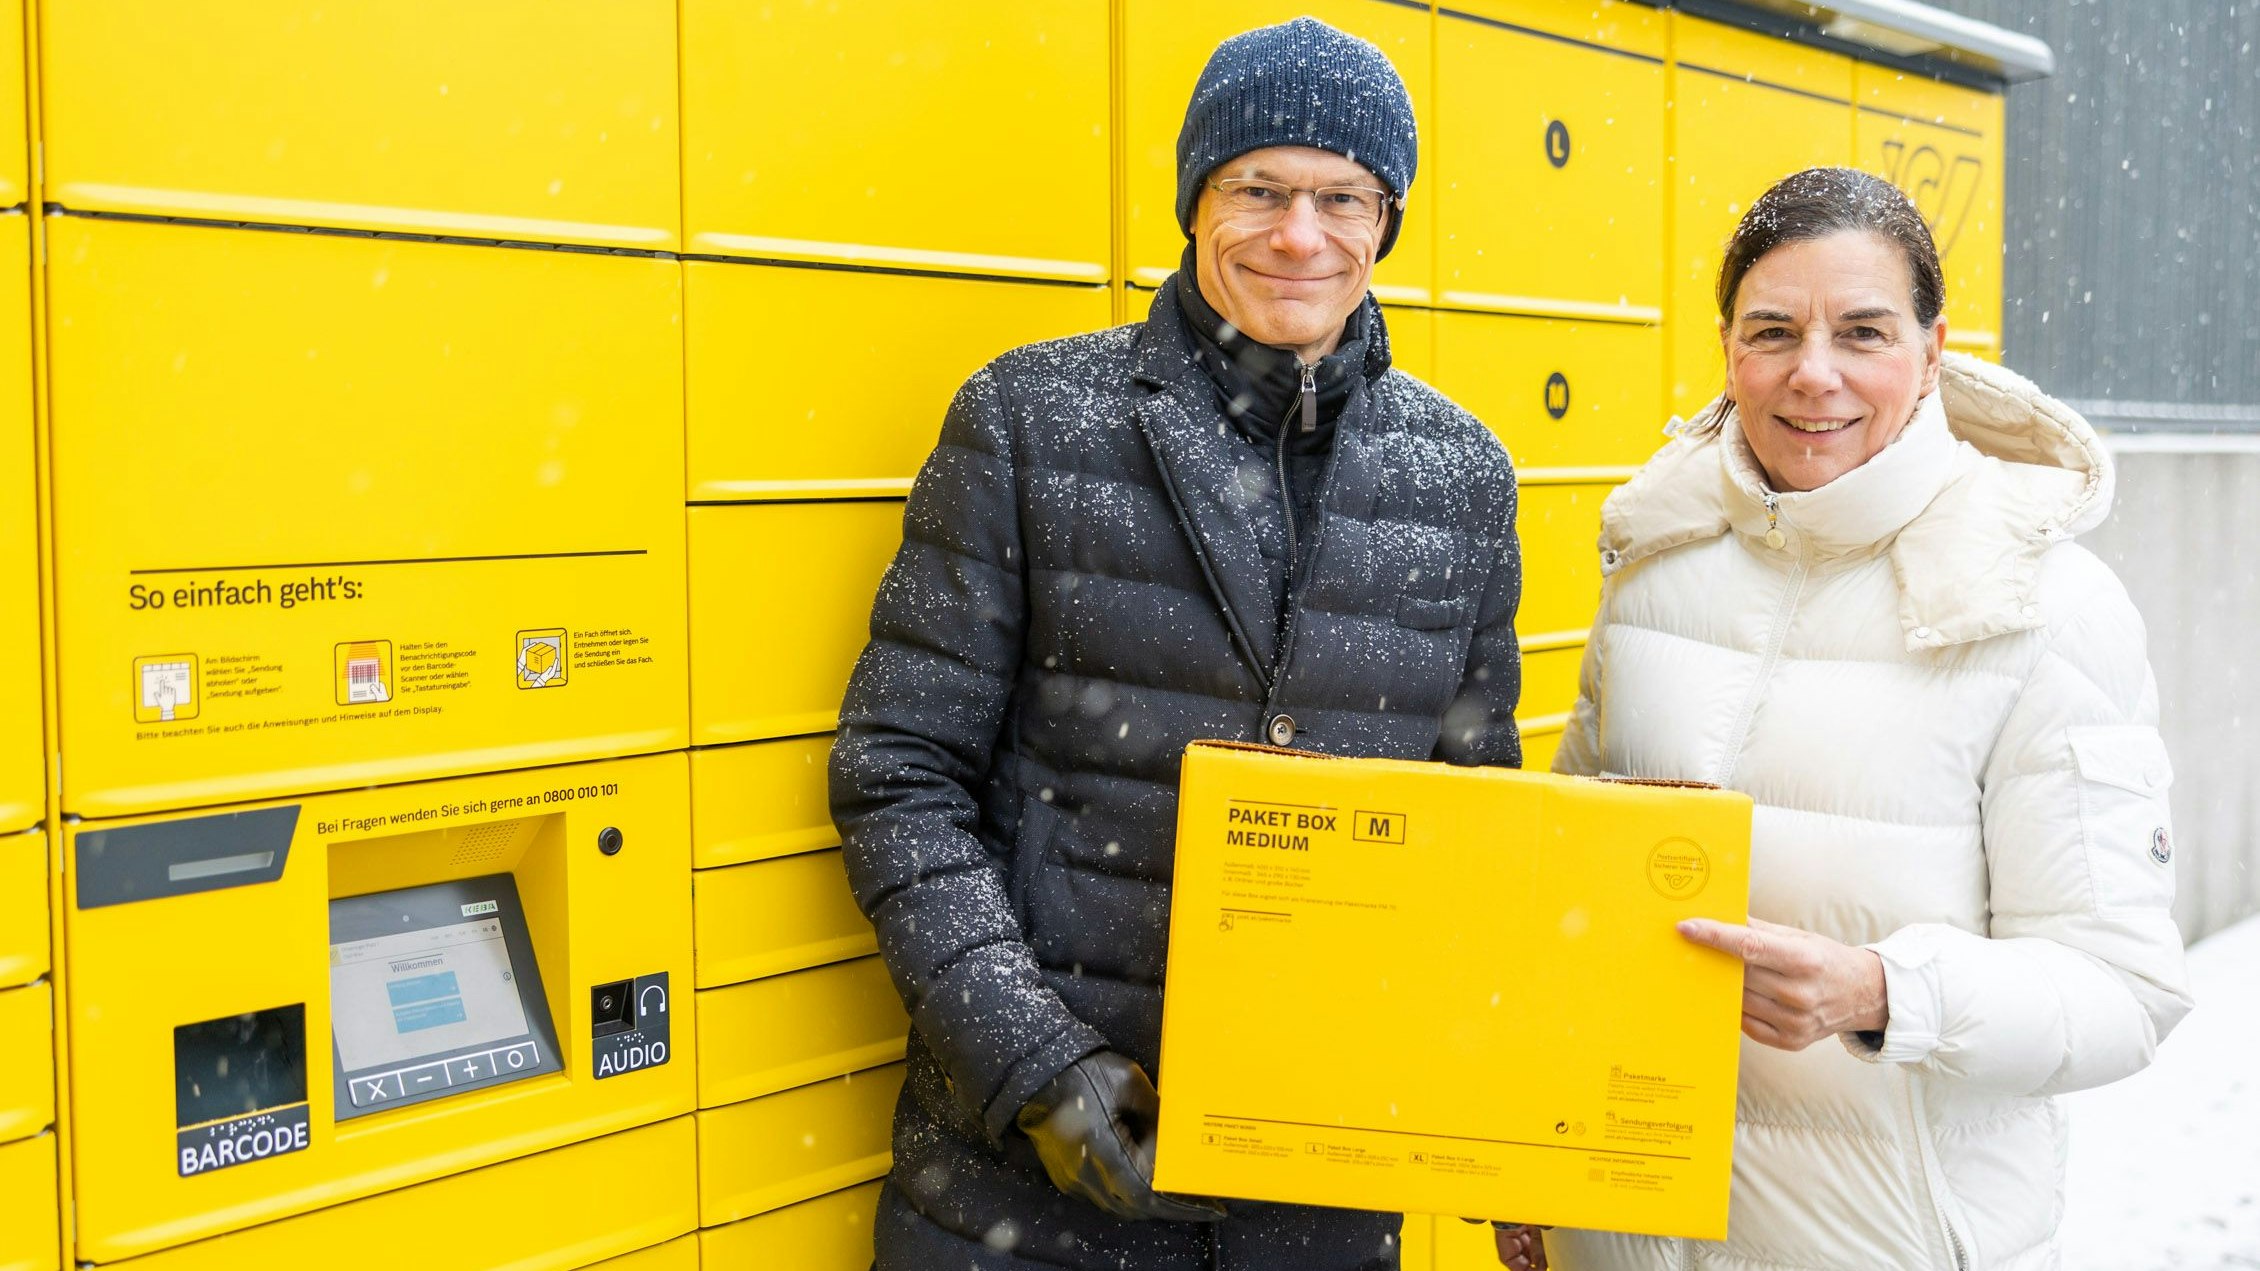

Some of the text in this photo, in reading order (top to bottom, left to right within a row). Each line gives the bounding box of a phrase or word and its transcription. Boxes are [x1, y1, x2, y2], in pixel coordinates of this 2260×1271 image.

[1552, 130, 1564, 158] L
[1549, 382, 1566, 410] M
[130, 576, 363, 610] So einfach geht’s:
[585, 630, 598, 638] Fach
[600, 628, 618, 637] öffnet
[574, 640, 608, 649] Entnehmen
[624, 637, 639, 646] legen
[220, 655, 260, 664] Bildschirm
[400, 650, 477, 662] Benachrichtigungscode
[585, 649, 610, 658] Sendung
[587, 659, 615, 668] schließen
[206, 667, 232, 676] wählen
[401, 674, 427, 683] Scanner
[136, 732, 159, 741] Bitte
[162, 728, 204, 738] beachten
[207, 726, 220, 734] Sie
[224, 722, 244, 732] auch
[247, 721, 261, 730] die
[263, 716, 319, 730] Anweisungen
[321, 715, 337, 724] und
[340, 711, 377, 721] Hinweise
[379, 710, 392, 718] auf
[394, 708, 410, 717] dem
[317, 783, 618, 835] Bei Fragen wenden Sie sich gerne an 0800 010 101
[1229, 808, 1337, 832] PAKET BOX
[1368, 817, 1390, 837] M
[1226, 830, 1309, 851] MEDIUM
[464, 902, 496, 914] KEBA
[390, 957, 444, 973] Willkommen
[598, 1041, 666, 1076] AUDIO
[1624, 1072, 1666, 1082] Paketmarke
[1620, 1118, 1693, 1132] Sendungsverfolgung
[181, 1122, 308, 1175] BARCODE
[1413, 1154, 1424, 1162] XL
